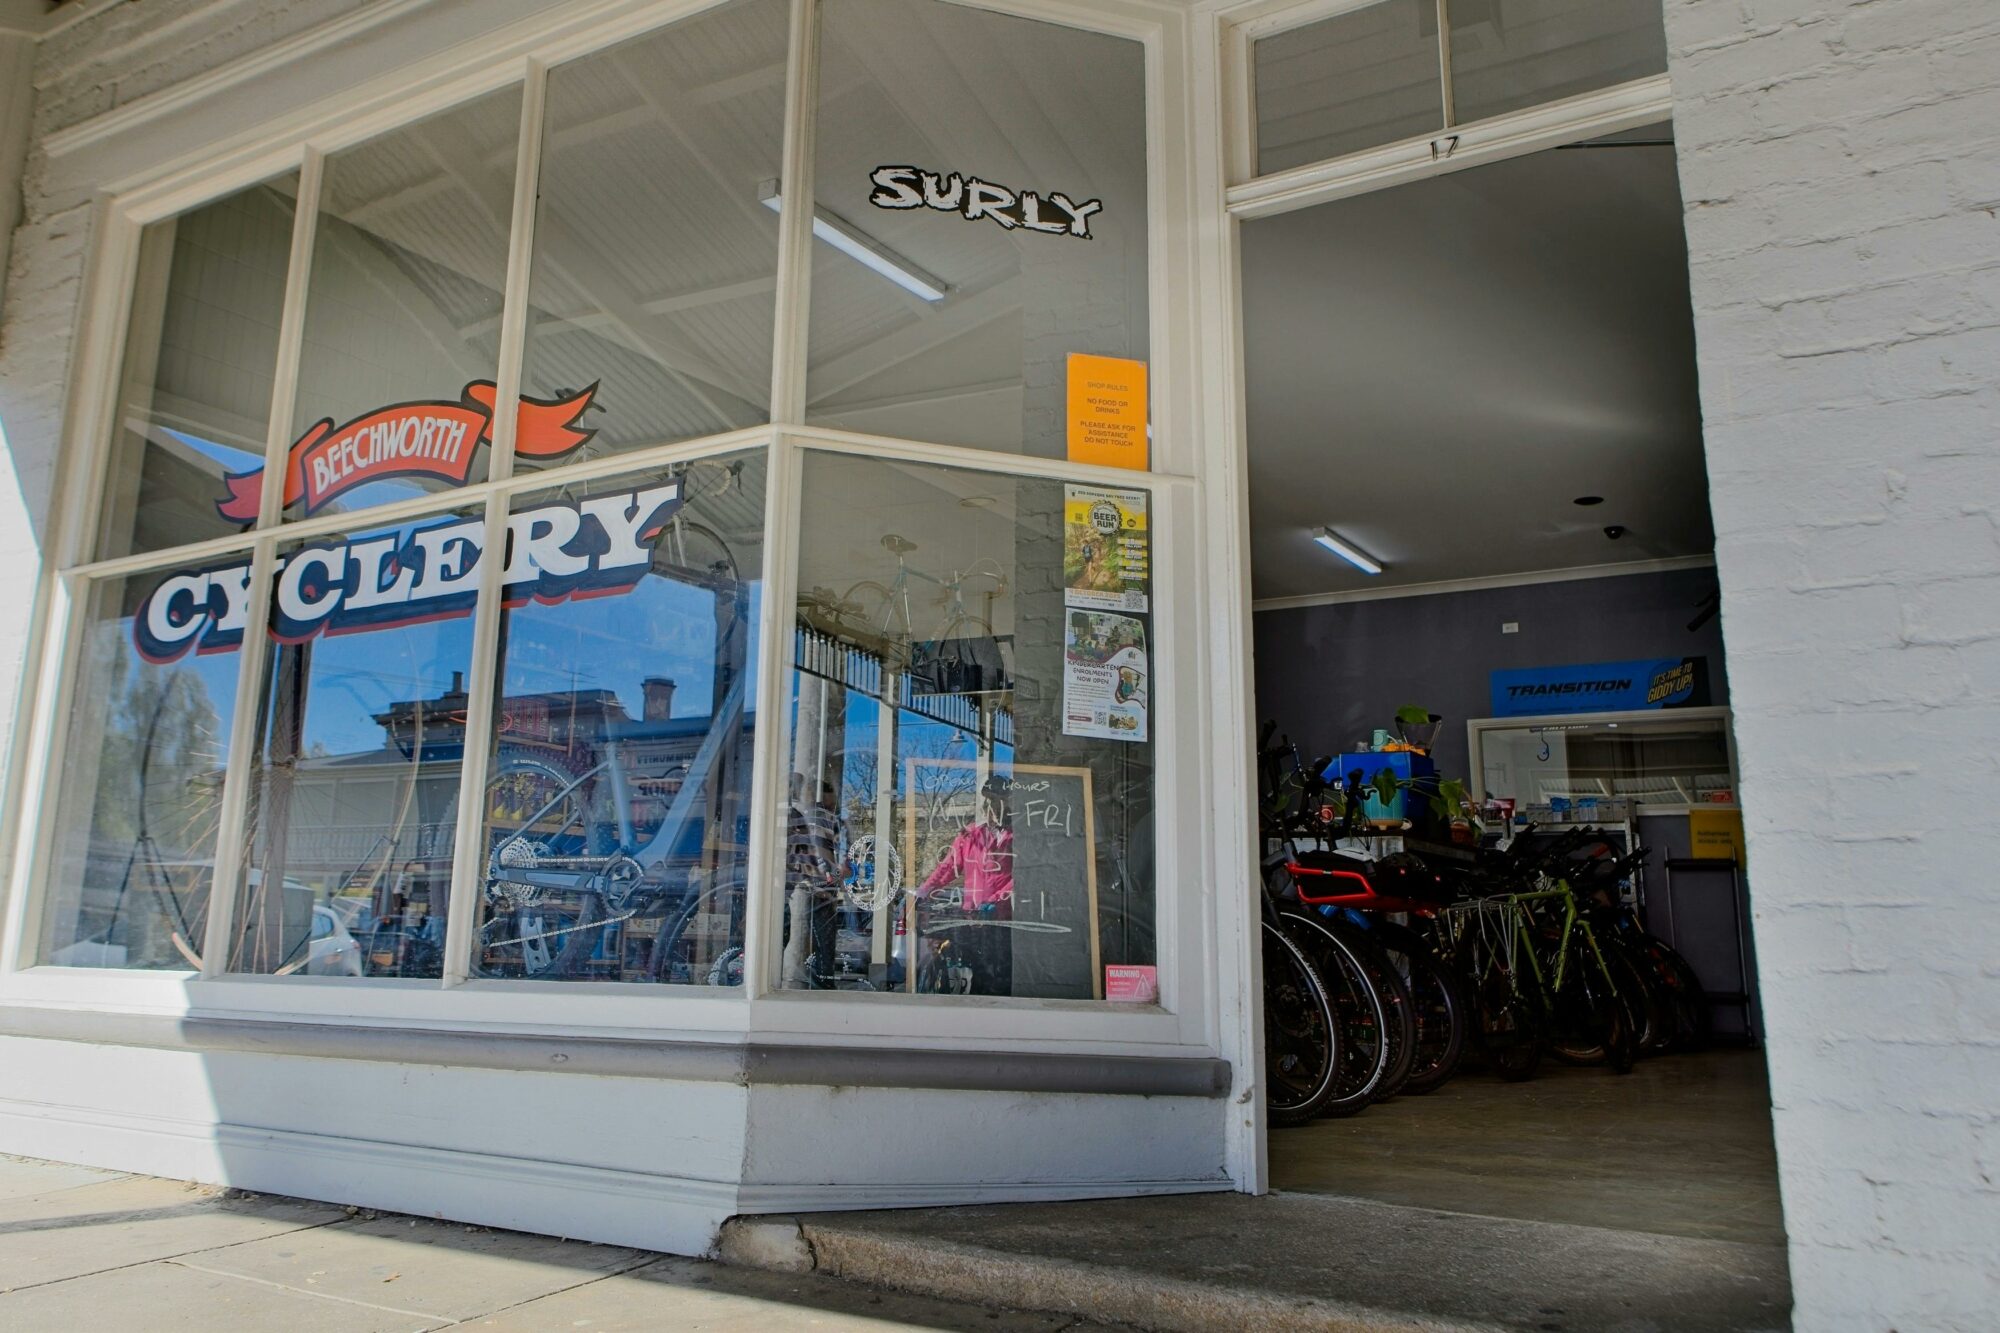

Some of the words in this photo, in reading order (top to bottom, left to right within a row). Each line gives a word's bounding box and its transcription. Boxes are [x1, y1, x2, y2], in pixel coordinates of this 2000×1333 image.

[1430, 135, 1458, 159] 17
[869, 165, 1103, 239] SURLY
[1087, 397, 1097, 405] NO
[1098, 399, 1117, 407] FOOD
[1119, 400, 1129, 408] OR
[1095, 406, 1120, 415] DRINKS
[1080, 420, 1106, 429] PLEASE
[1107, 423, 1120, 431] ASK
[1122, 424, 1136, 432] FOR
[1088, 430, 1128, 439] ASSISTANCE
[1111, 439, 1133, 447] TOUCH
[313, 415, 468, 496] BEECHWORTH
[1093, 512, 1117, 522] BEER
[1096, 520, 1114, 529] RUN
[145, 482, 680, 645] CYCLERY
[1068, 660, 1120, 671] KINDERGARTEN
[1073, 668, 1113, 678] ENROLMENTS
[1652, 673, 1667, 687] IT'S
[1667, 666, 1684, 682] TIME
[1684, 661, 1693, 674] TO
[1093, 677, 1109, 685] OPEN
[1507, 678, 1632, 697] TRANSITION
[1647, 682, 1676, 704] GIDDY
[1675, 673, 1693, 693] UP!
[1003, 780, 1050, 792] HOURS
[1109, 969, 1141, 978] WARNING
